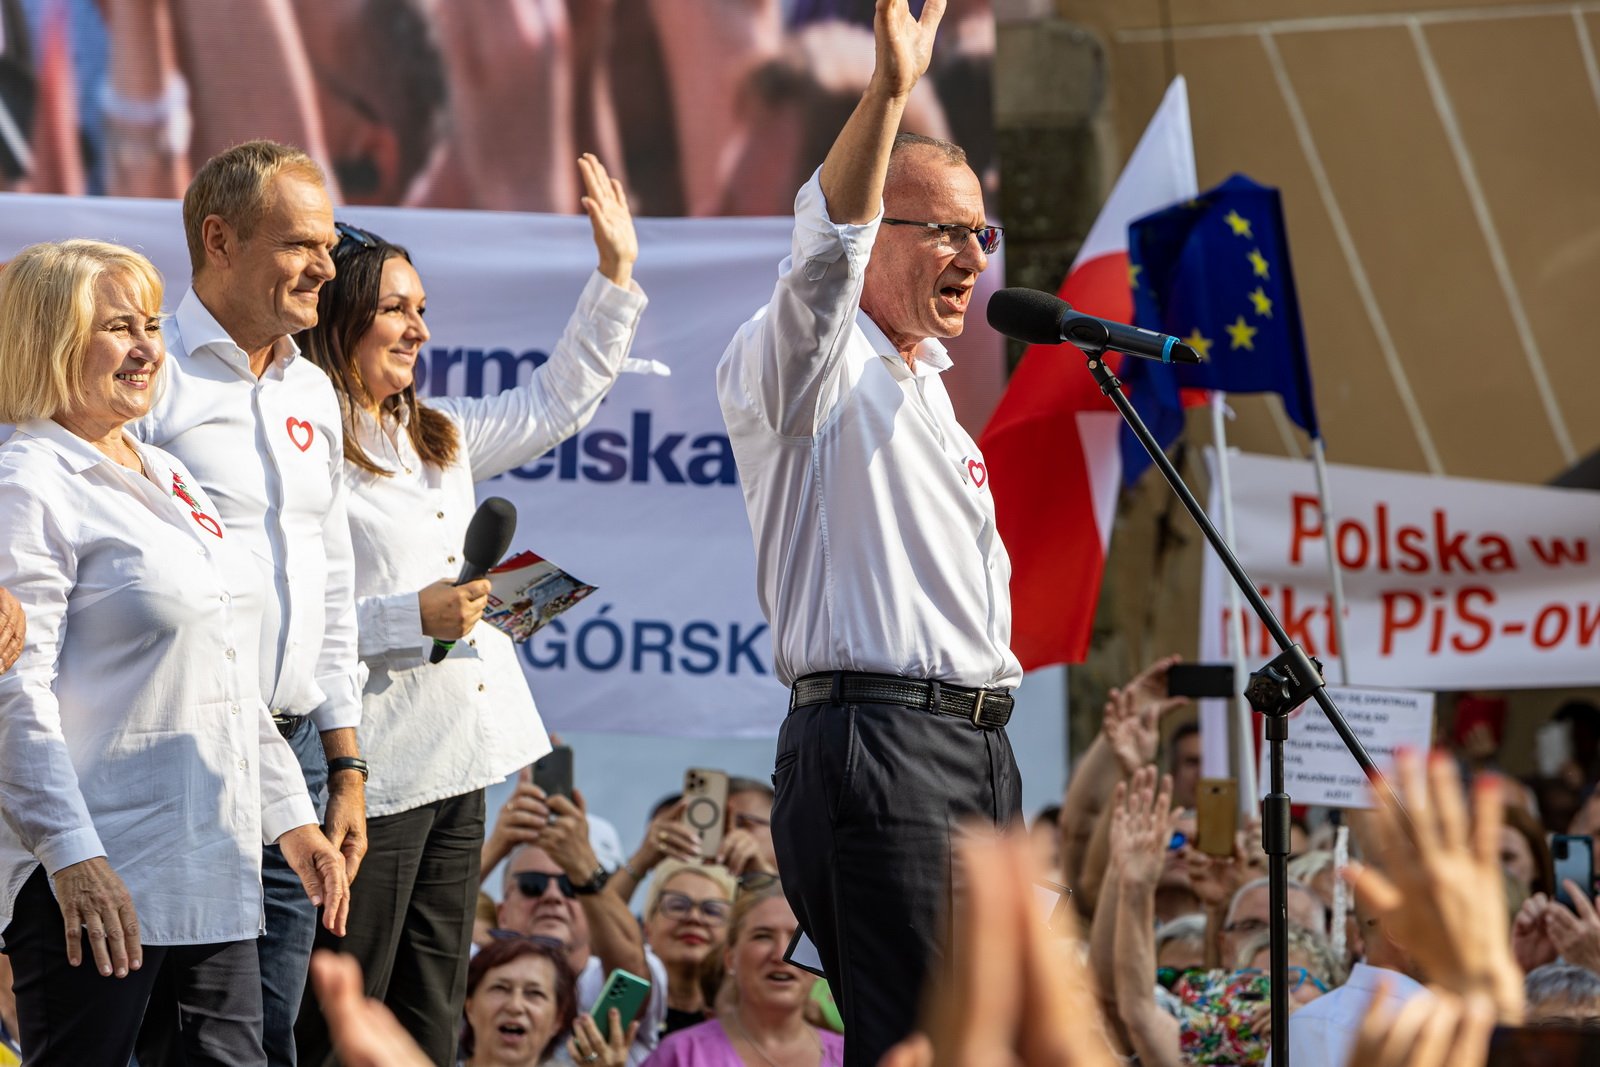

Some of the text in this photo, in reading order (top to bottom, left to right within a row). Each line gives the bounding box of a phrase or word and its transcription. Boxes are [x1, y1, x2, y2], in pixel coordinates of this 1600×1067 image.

[1288, 491, 1588, 574] Polska w
[523, 603, 770, 676] GÓRSK
